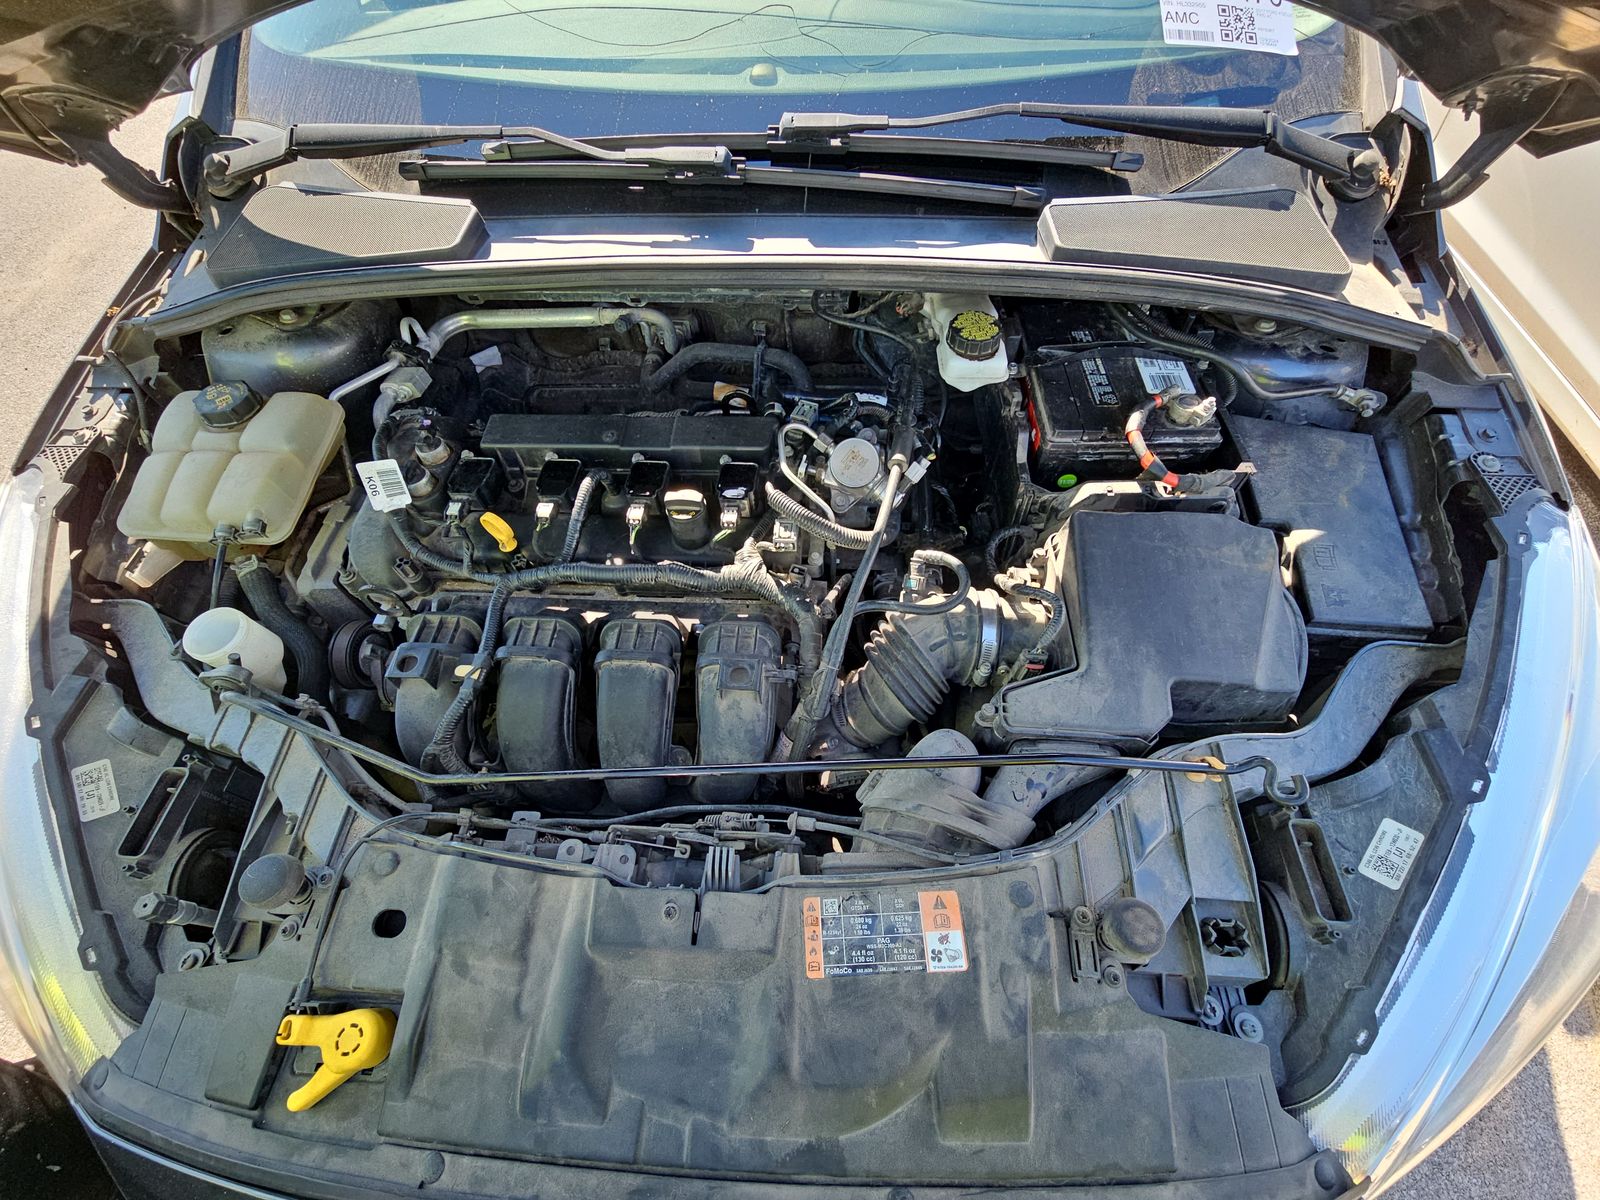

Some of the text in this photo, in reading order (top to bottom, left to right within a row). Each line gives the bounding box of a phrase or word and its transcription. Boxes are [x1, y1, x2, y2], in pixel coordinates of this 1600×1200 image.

[1164, 10, 1200, 24] AMC
[365, 476, 380, 497] K06
[85, 790, 96, 800] [J]
[1393, 847, 1406, 858] [J]
